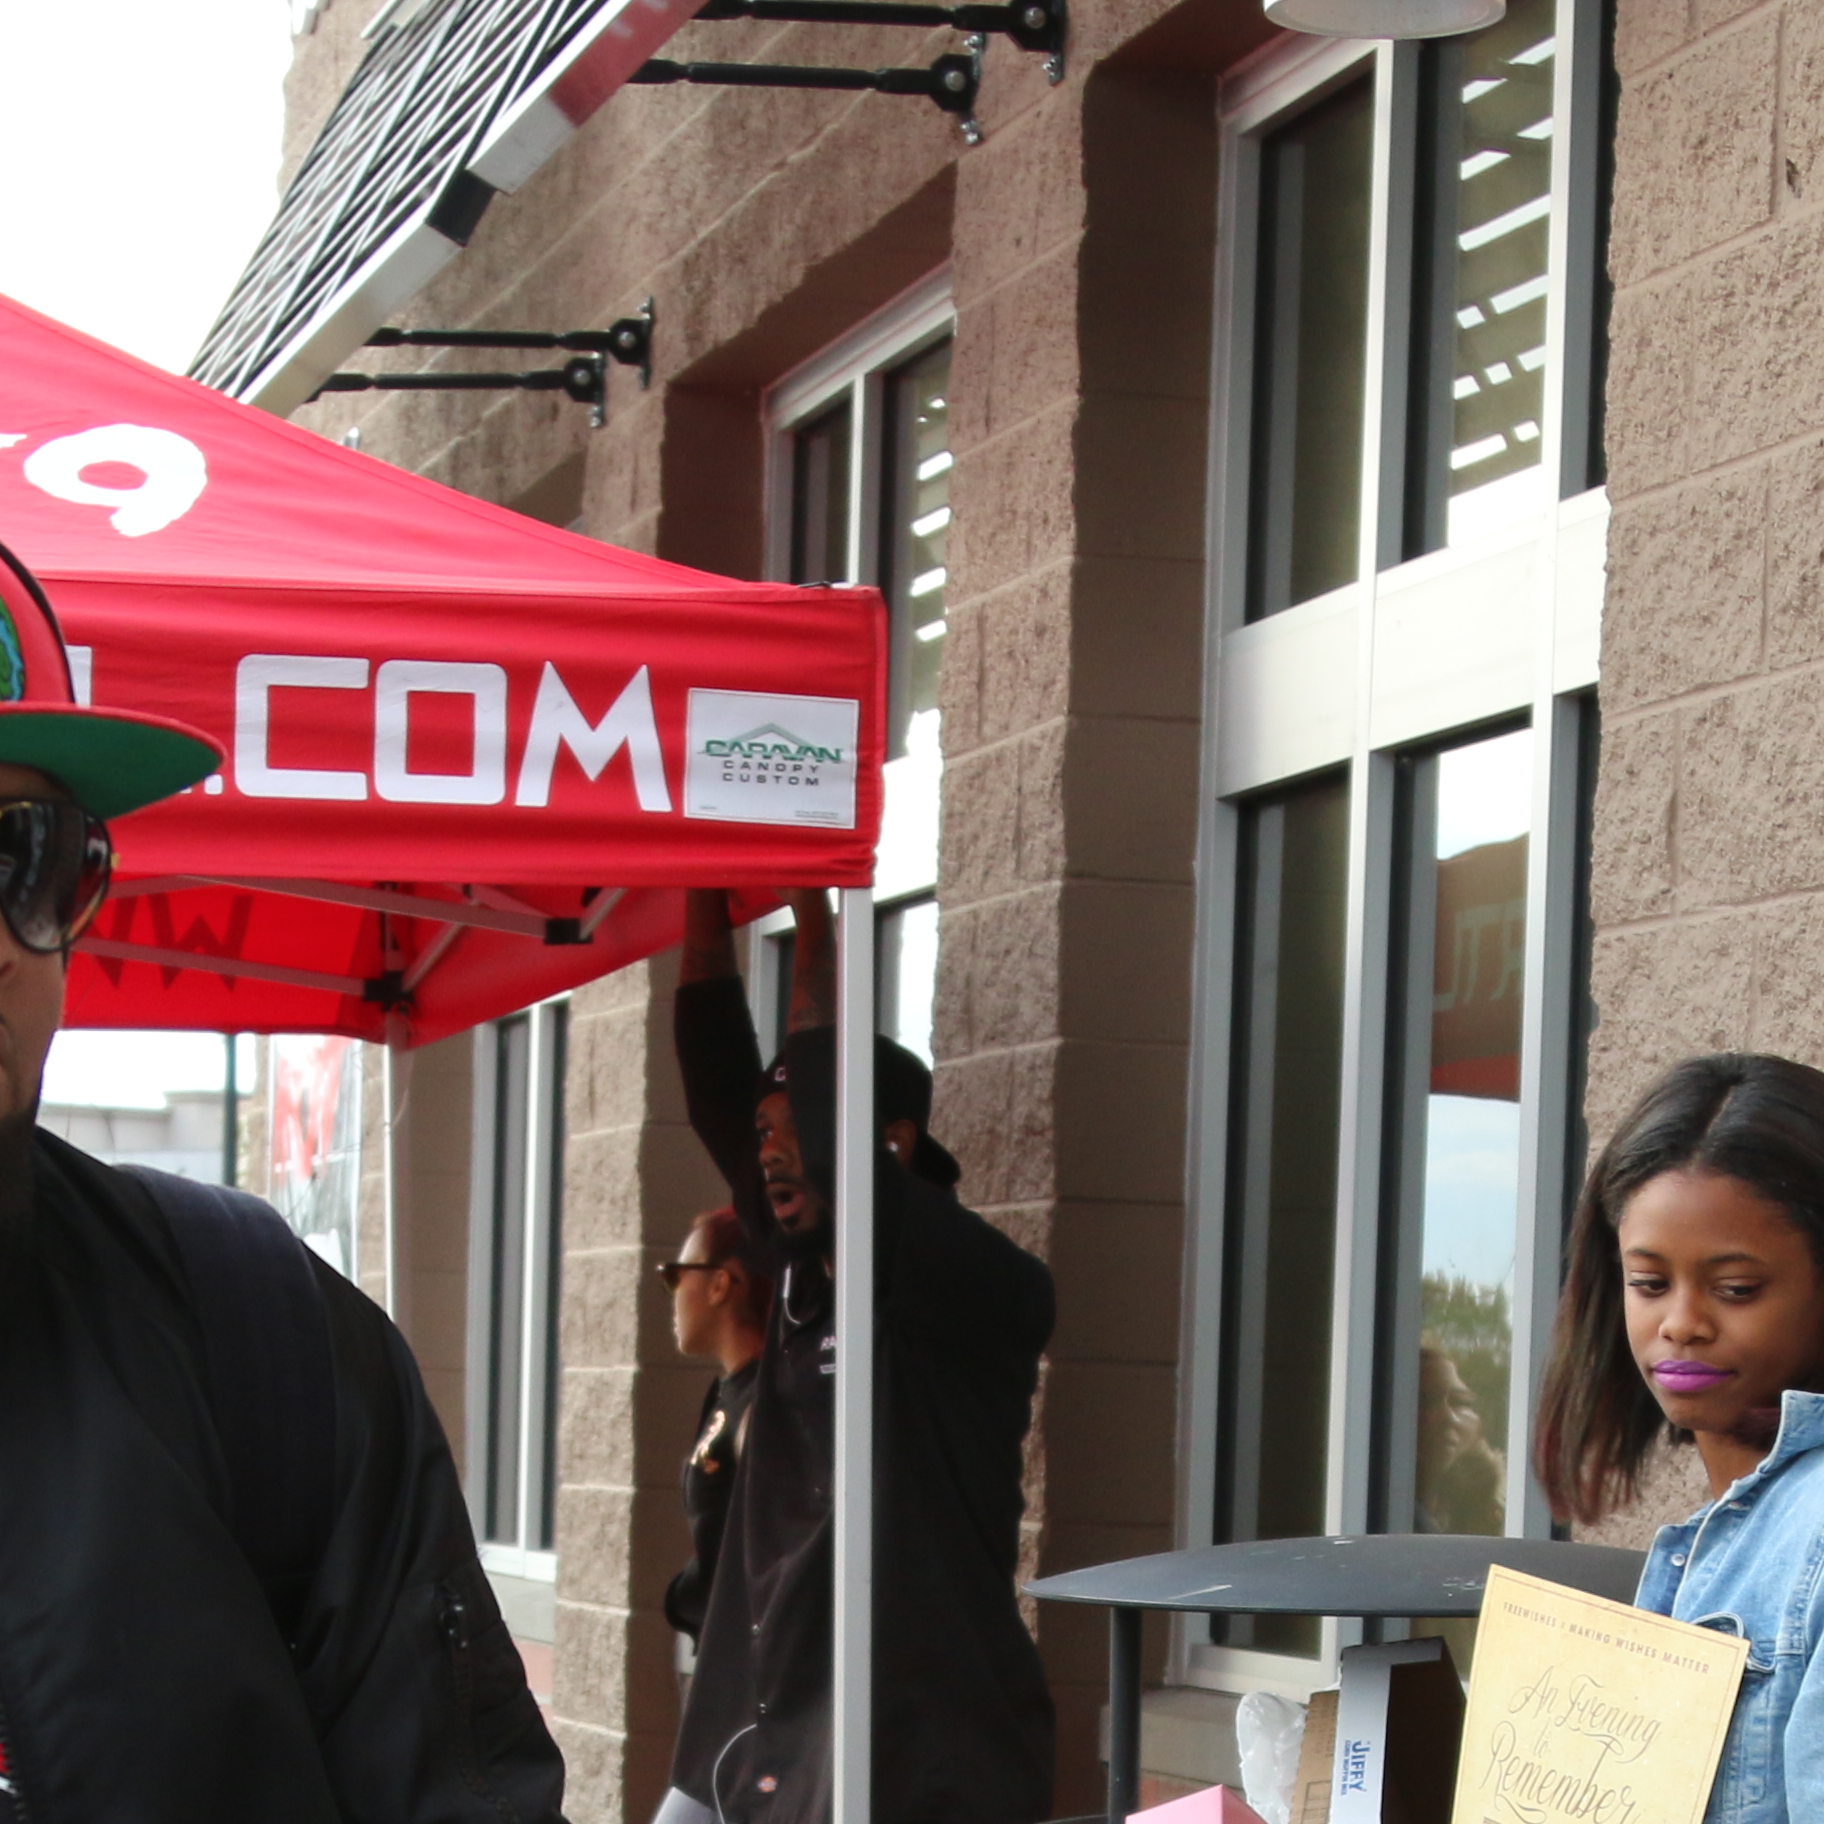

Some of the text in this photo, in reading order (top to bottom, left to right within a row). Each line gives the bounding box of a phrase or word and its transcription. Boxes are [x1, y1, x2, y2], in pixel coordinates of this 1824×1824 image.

[704, 739, 842, 764] CARAVAN
[723, 759, 820, 773] CANOPY
[722, 772, 820, 786] CUSTOM
[1502, 1601, 1711, 1675] FREEWISHES MAKING WISHES MATTER
[1507, 1665, 1664, 1764] An Evening
[1349, 1740, 1371, 1793] JIFFY
